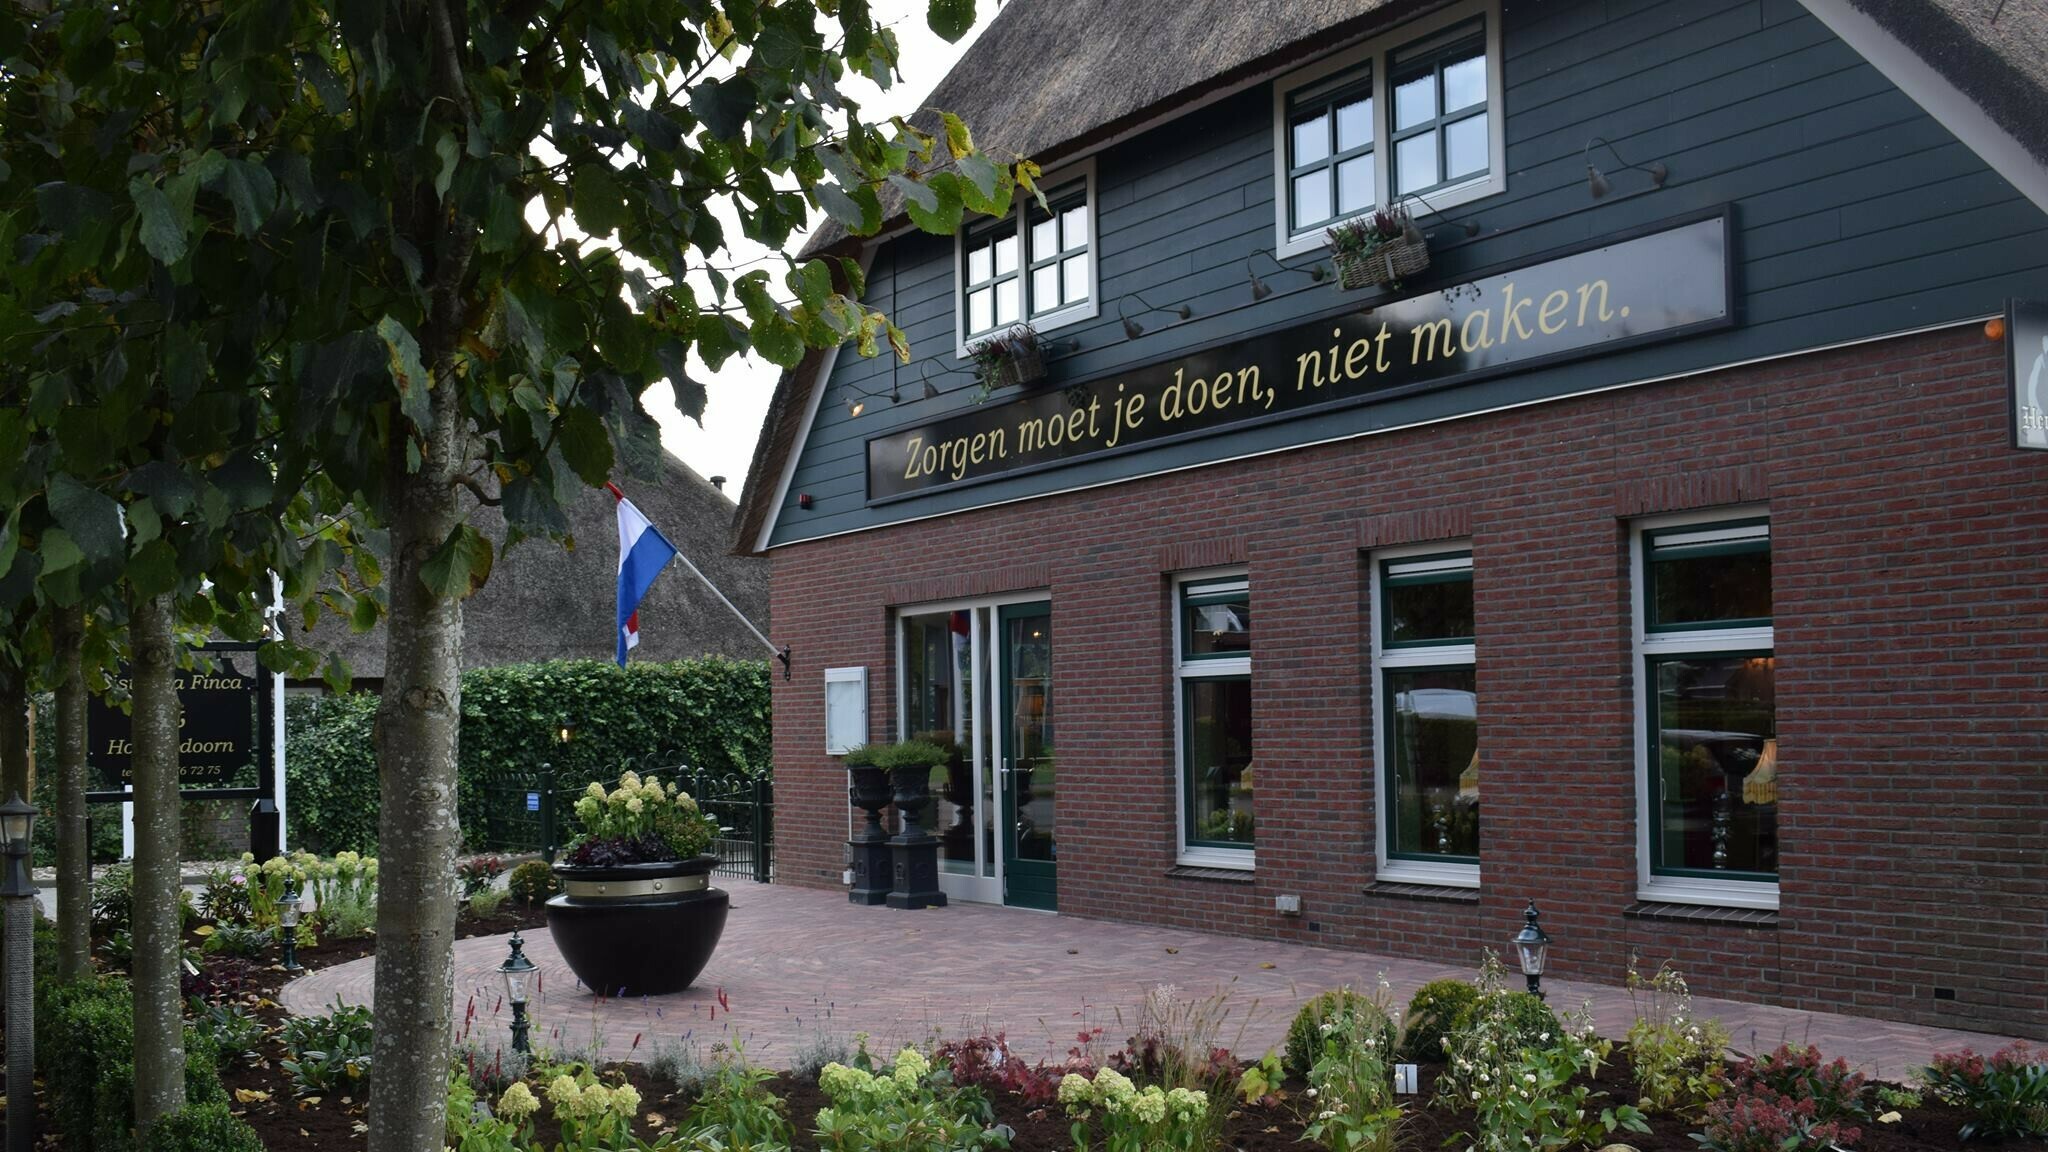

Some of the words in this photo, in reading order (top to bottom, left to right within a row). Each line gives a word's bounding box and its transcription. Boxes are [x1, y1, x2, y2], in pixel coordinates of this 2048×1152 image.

[904, 425, 1007, 481] Zorgen
[1018, 394, 1100, 454] moet
[1106, 383, 1145, 448] je
[1159, 364, 1276, 421] doen,
[1296, 327, 1392, 391] niet
[1410, 279, 1631, 365] maken.
[190, 674, 243, 690] Finca
[190, 765, 204, 776] 72
[207, 765, 221, 776] 75
